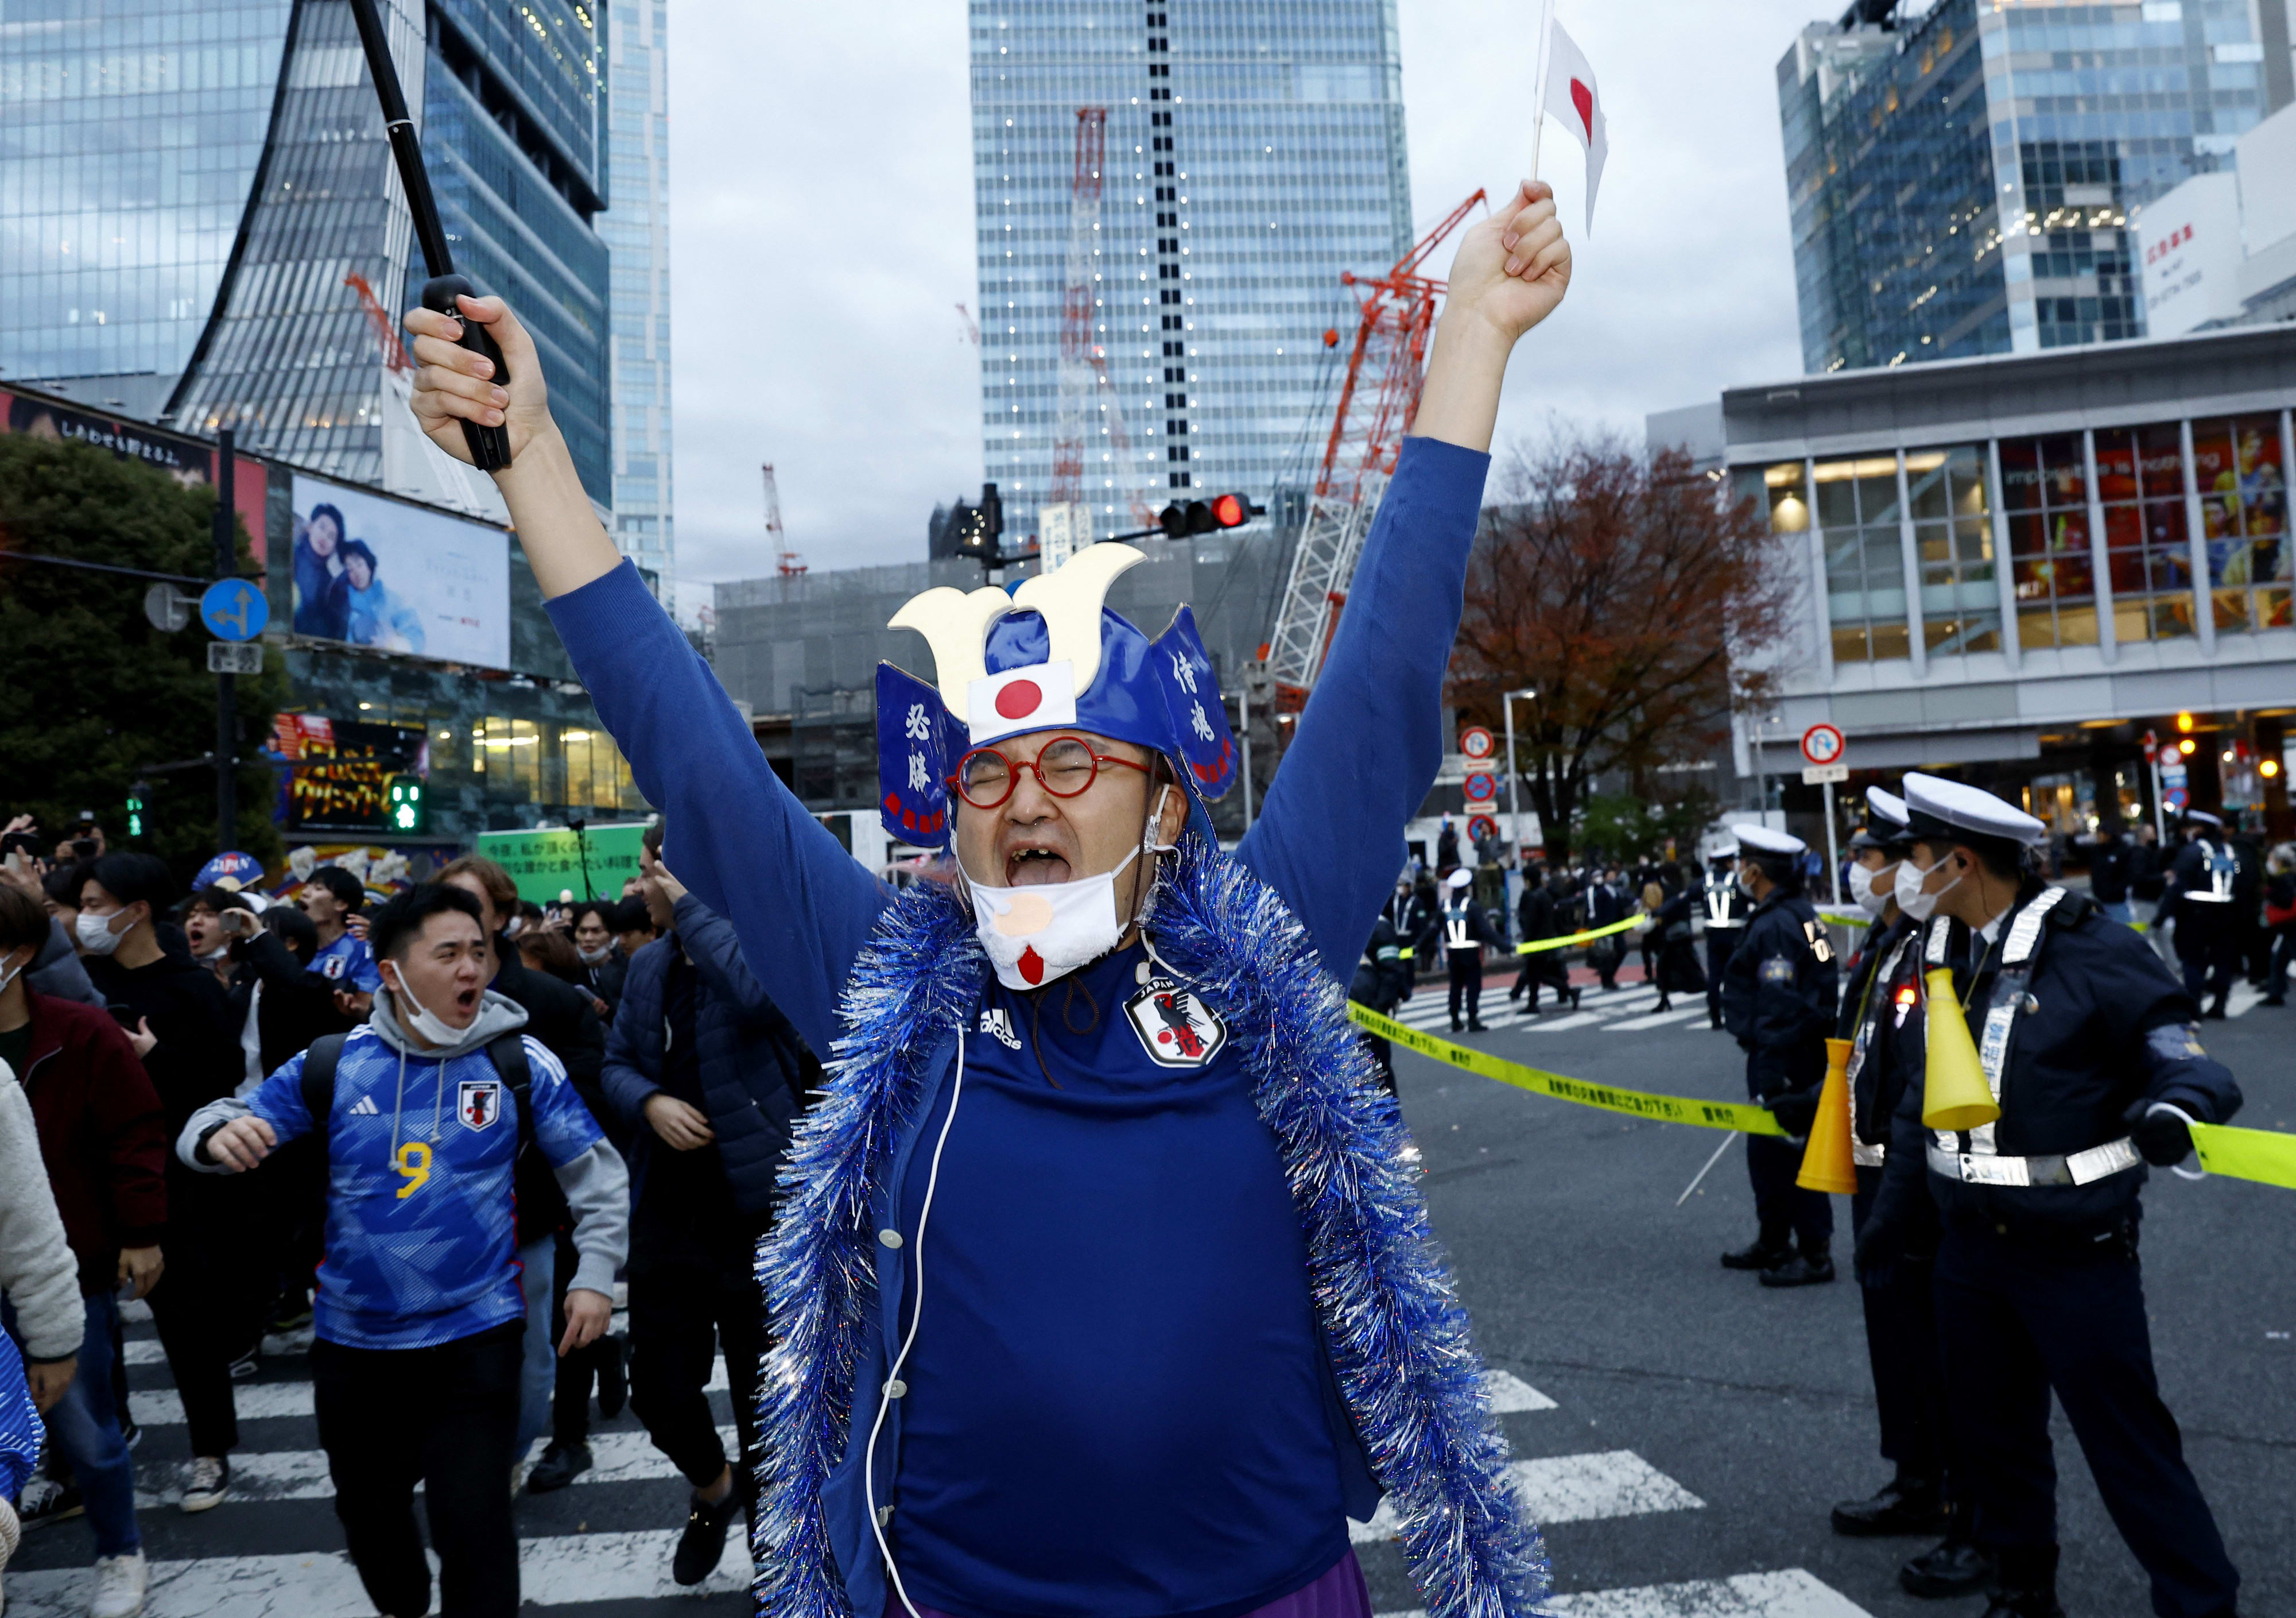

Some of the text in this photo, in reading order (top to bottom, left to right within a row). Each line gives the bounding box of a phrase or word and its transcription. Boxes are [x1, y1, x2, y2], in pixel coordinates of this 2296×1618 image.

[1172, 650, 1215, 742] 侍魂
[905, 703, 932, 793] 必勝
[210, 856, 252, 873] JAPAN
[1141, 980, 1174, 998] JAPAN
[980, 1018, 1022, 1050] didas
[1174, 1034, 1209, 1056] JFA
[396, 1141, 432, 1199] 9
